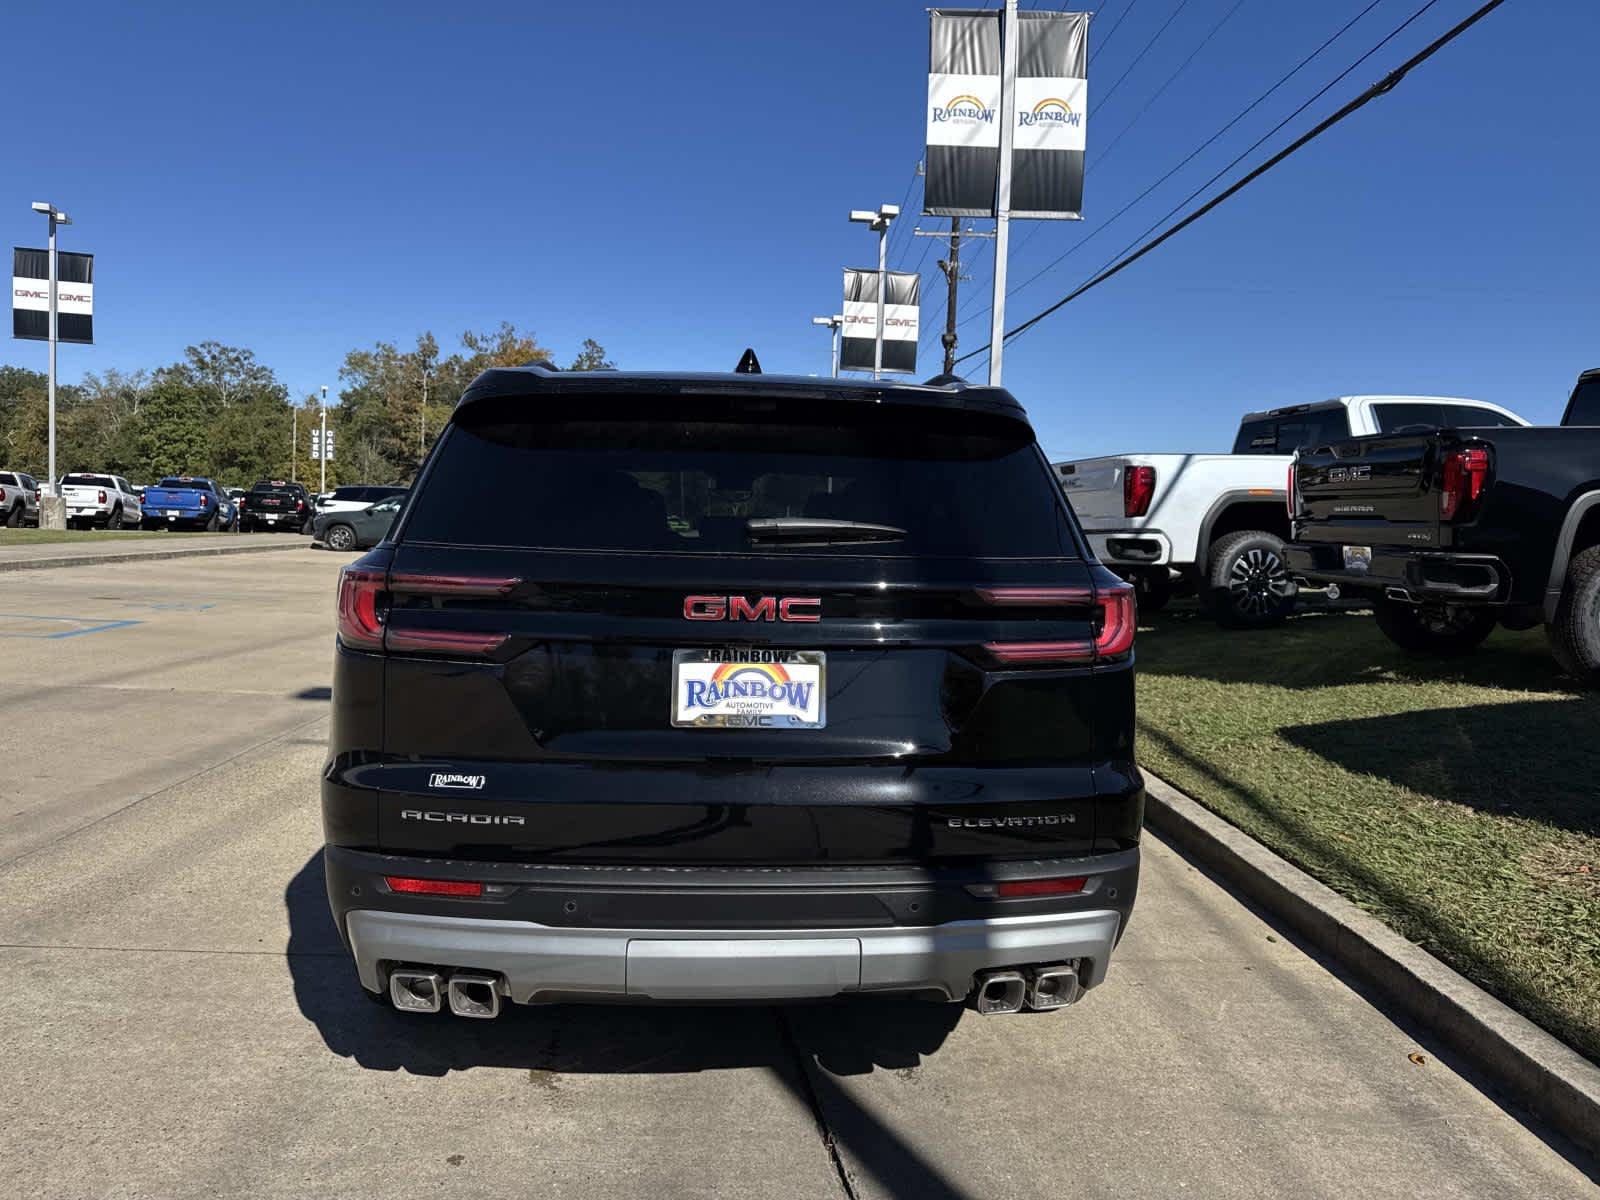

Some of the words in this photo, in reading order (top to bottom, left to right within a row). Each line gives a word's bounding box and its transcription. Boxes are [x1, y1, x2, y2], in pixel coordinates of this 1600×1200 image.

[932, 107, 996, 124] RAINBOW
[1018, 111, 1082, 127] RAINBOW
[14, 289, 49, 299] GMC
[58, 293, 91, 303] GMC
[844, 315, 876, 324] GMC
[885, 318, 917, 327] GMC
[683, 595, 822, 622] GMC
[710, 649, 789, 663] RAINBOW
[685, 680, 815, 711] RAINBOW
[725, 702, 774, 710] AUTOMOTIVE
[727, 715, 772, 727] GMC
[435, 773, 479, 787] RAINBOW
[401, 809, 526, 825] ACADIA
[948, 813, 1076, 828] ELEVATION
